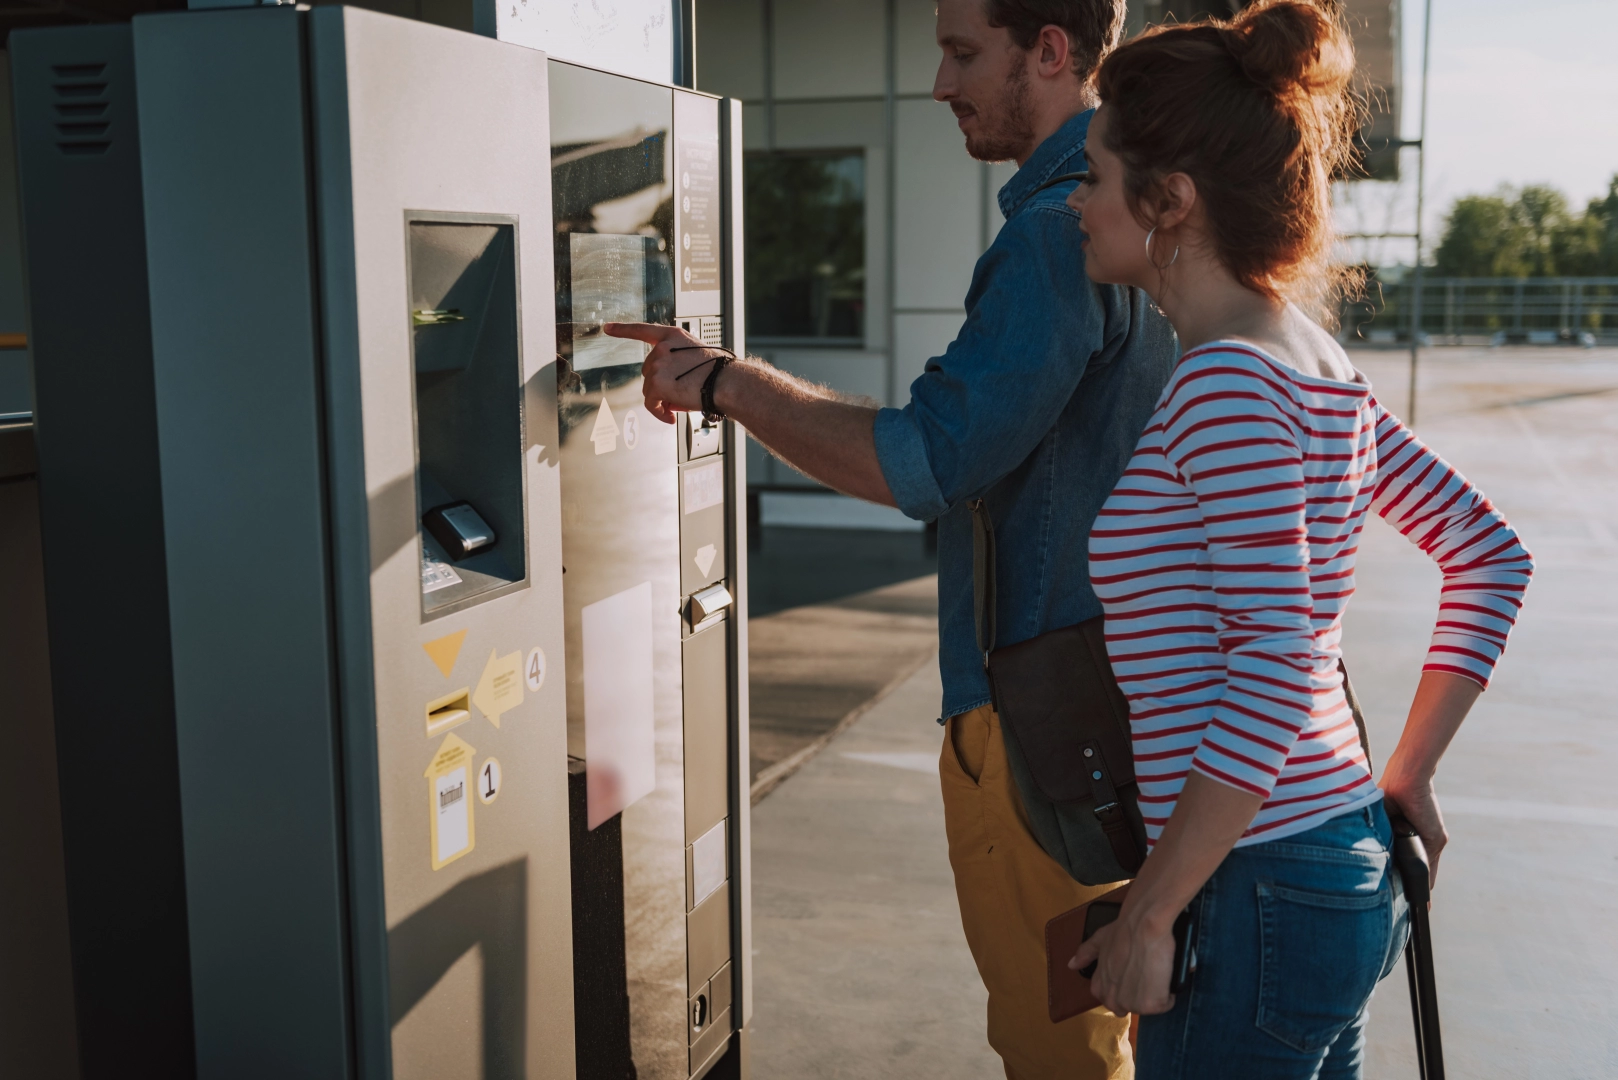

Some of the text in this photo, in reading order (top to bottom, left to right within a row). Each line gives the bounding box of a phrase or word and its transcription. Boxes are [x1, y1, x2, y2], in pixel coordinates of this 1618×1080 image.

[627, 416, 636, 447] 3
[529, 652, 541, 684] 4
[484, 763, 496, 798] 1
